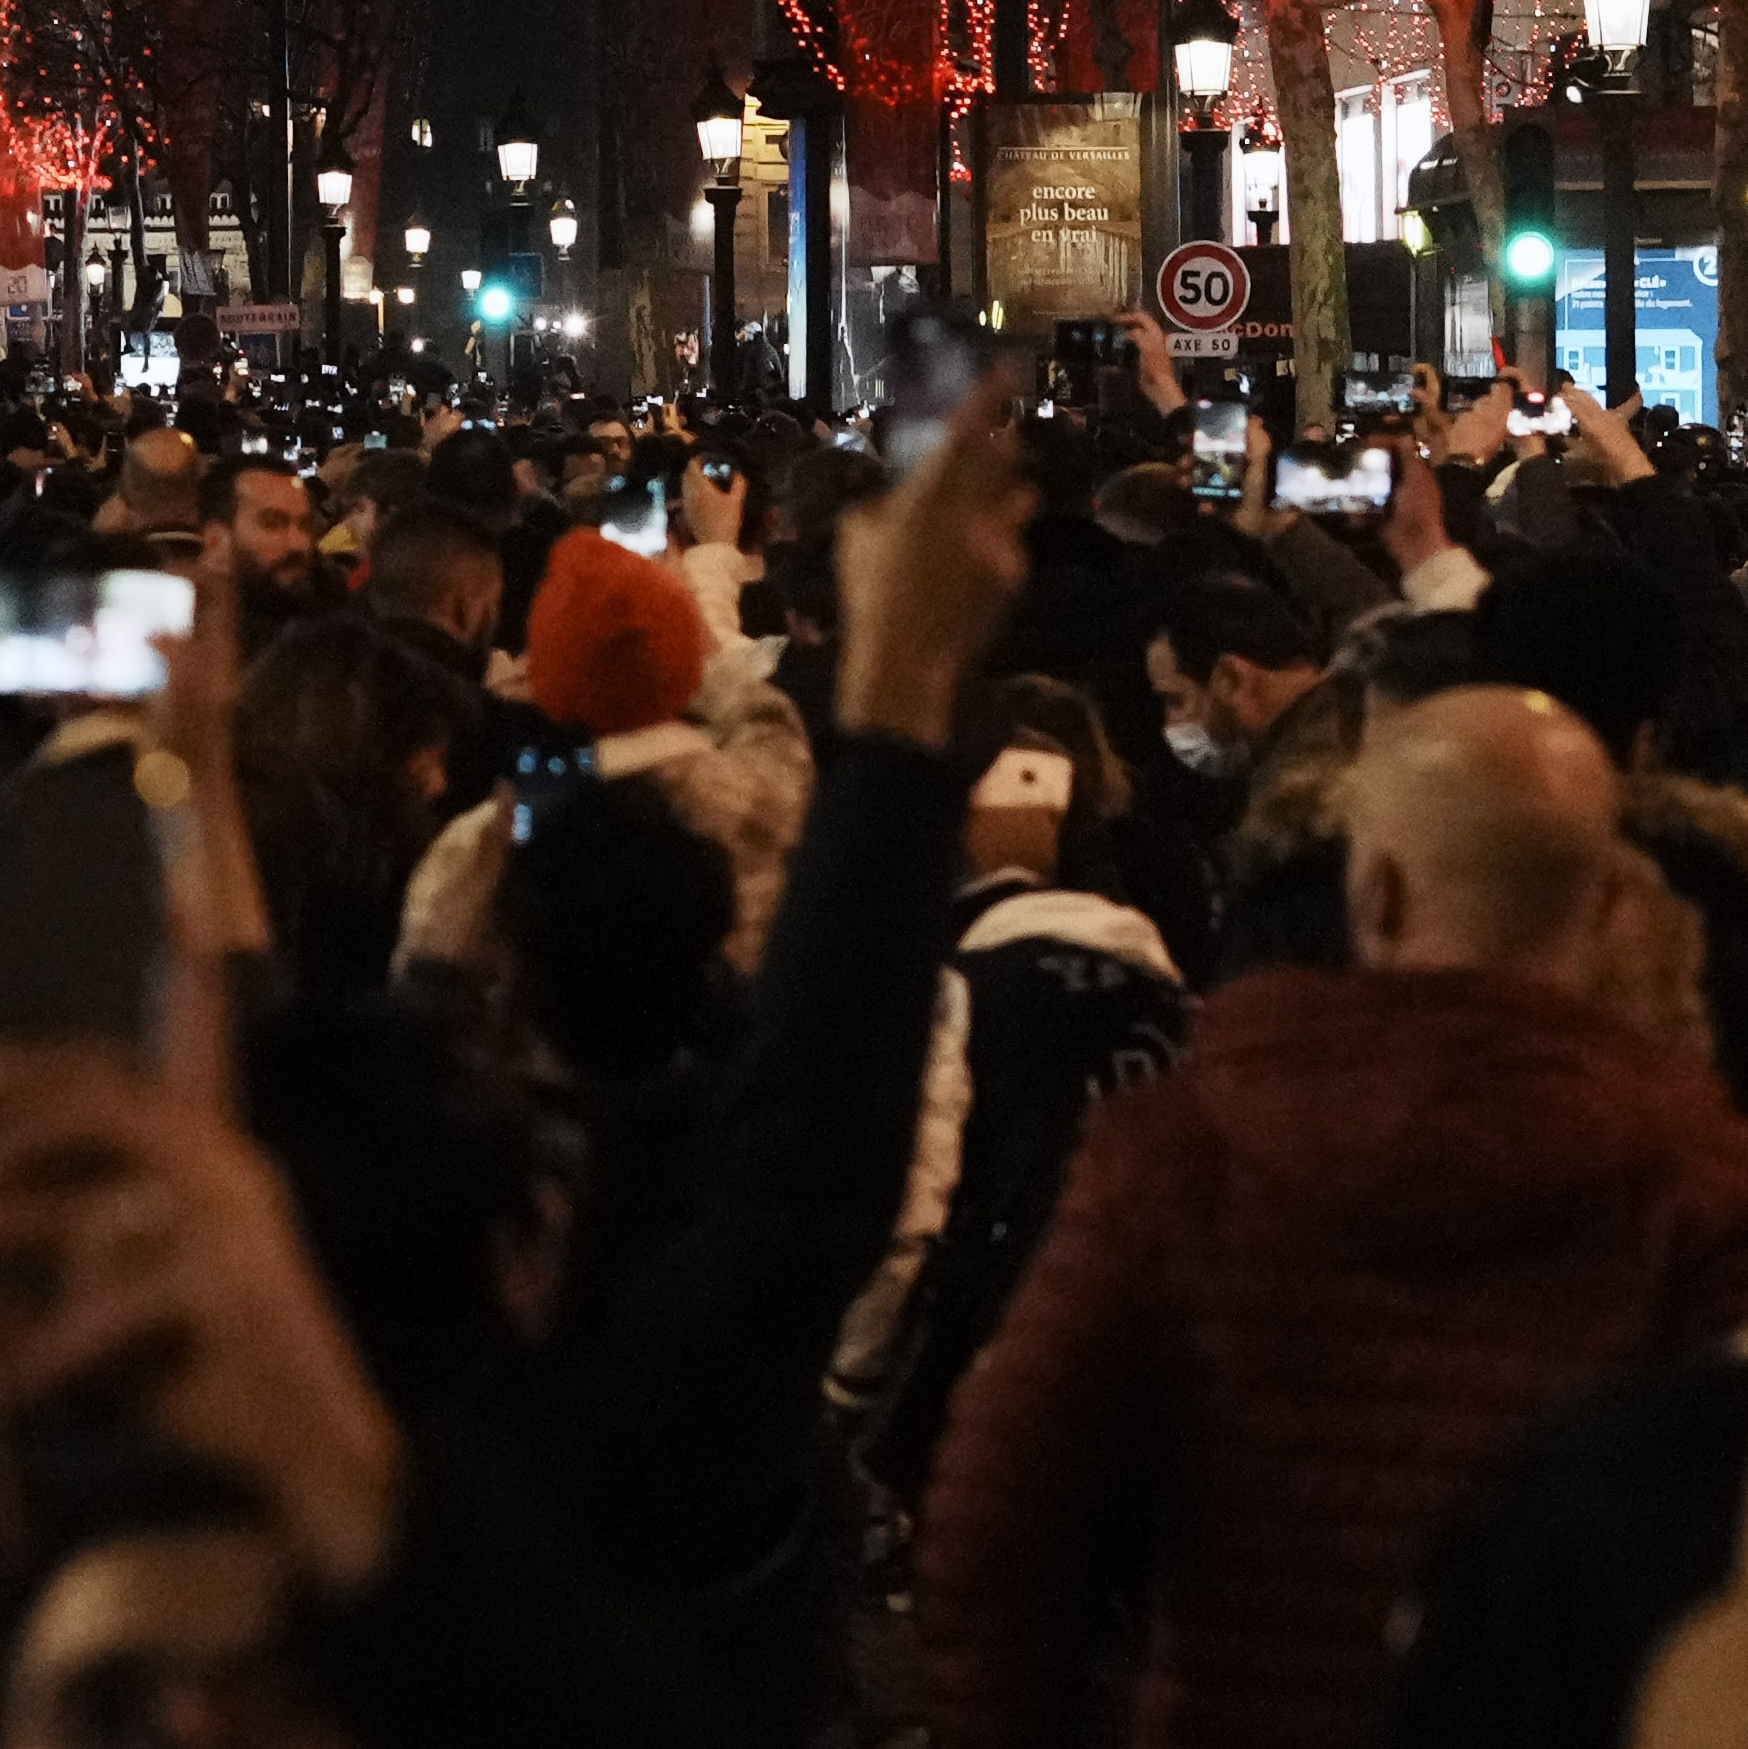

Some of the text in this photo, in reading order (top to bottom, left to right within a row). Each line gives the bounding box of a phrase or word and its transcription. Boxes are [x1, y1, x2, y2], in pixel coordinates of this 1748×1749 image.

[1051, 151, 1065, 160] DE
[1069, 151, 1130, 160] VERSAILLES
[1032, 185, 1096, 200] encore
[1019, 202, 1110, 227] plus beau
[1030, 224, 1098, 243] en vrai
[1178, 270, 1230, 306] 50
[1173, 338, 1231, 351] AXE 50
